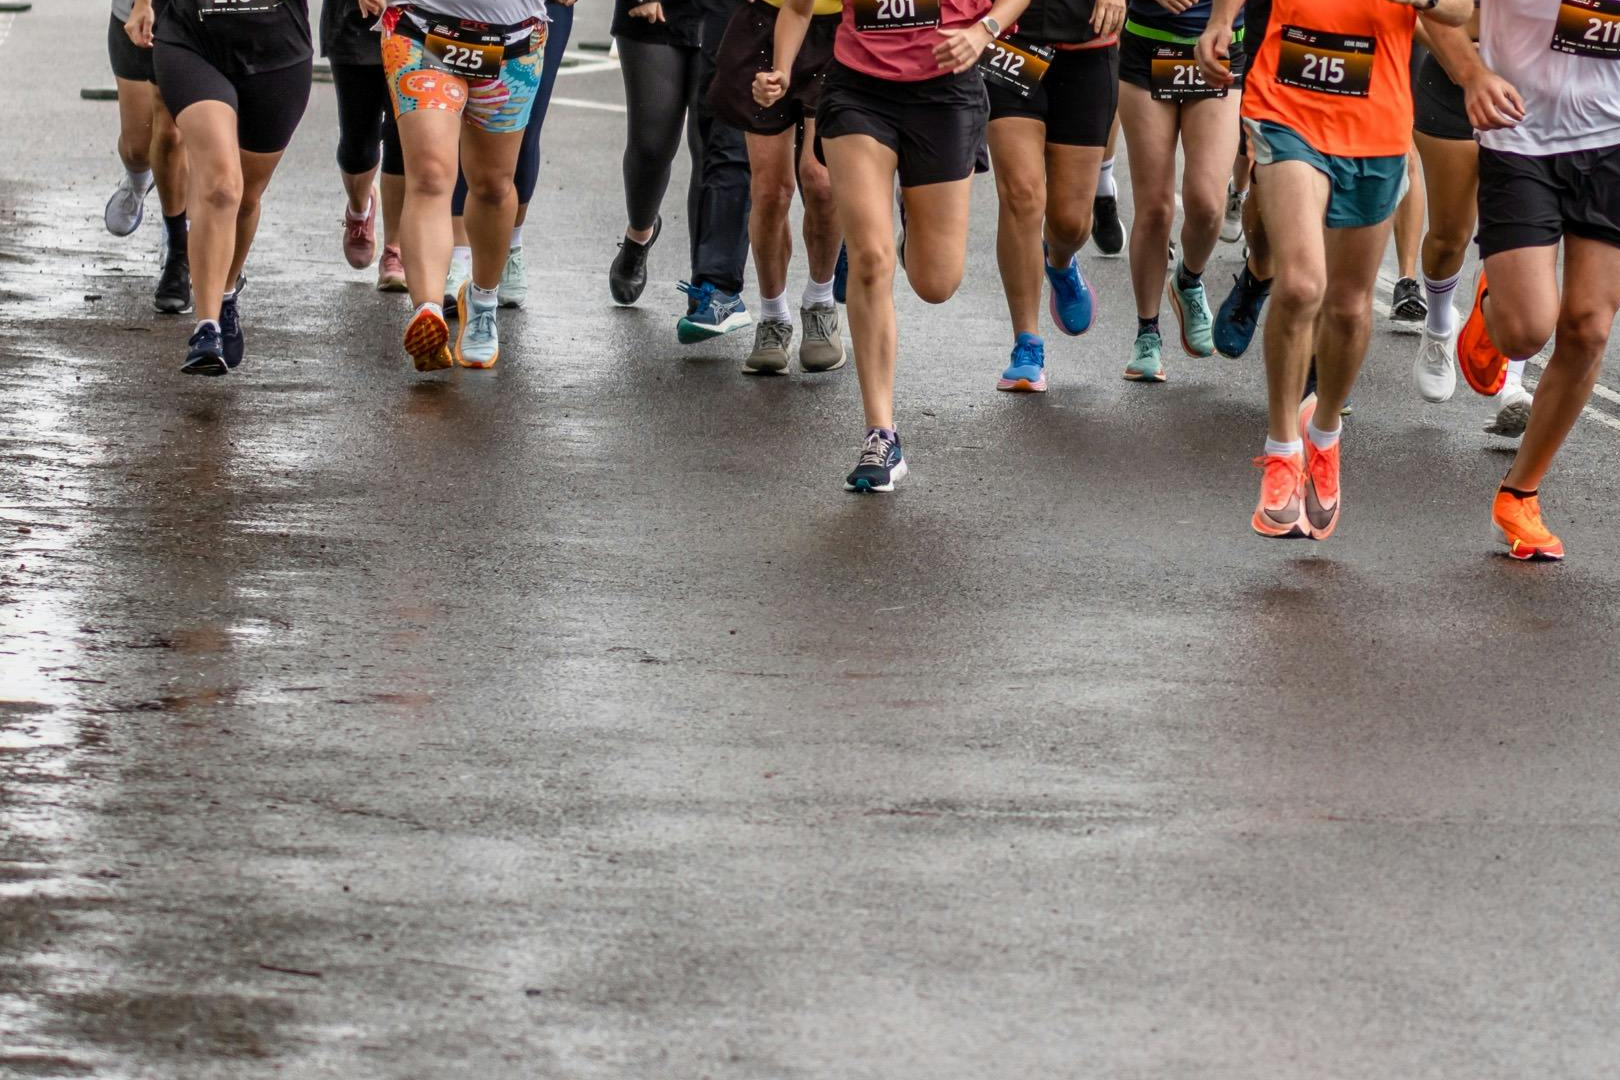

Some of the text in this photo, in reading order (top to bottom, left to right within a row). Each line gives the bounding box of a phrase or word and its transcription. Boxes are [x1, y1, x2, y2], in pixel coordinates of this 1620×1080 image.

[442, 44, 484, 70] 225
[989, 46, 1026, 77] 212
[1301, 53, 1346, 84] 215
